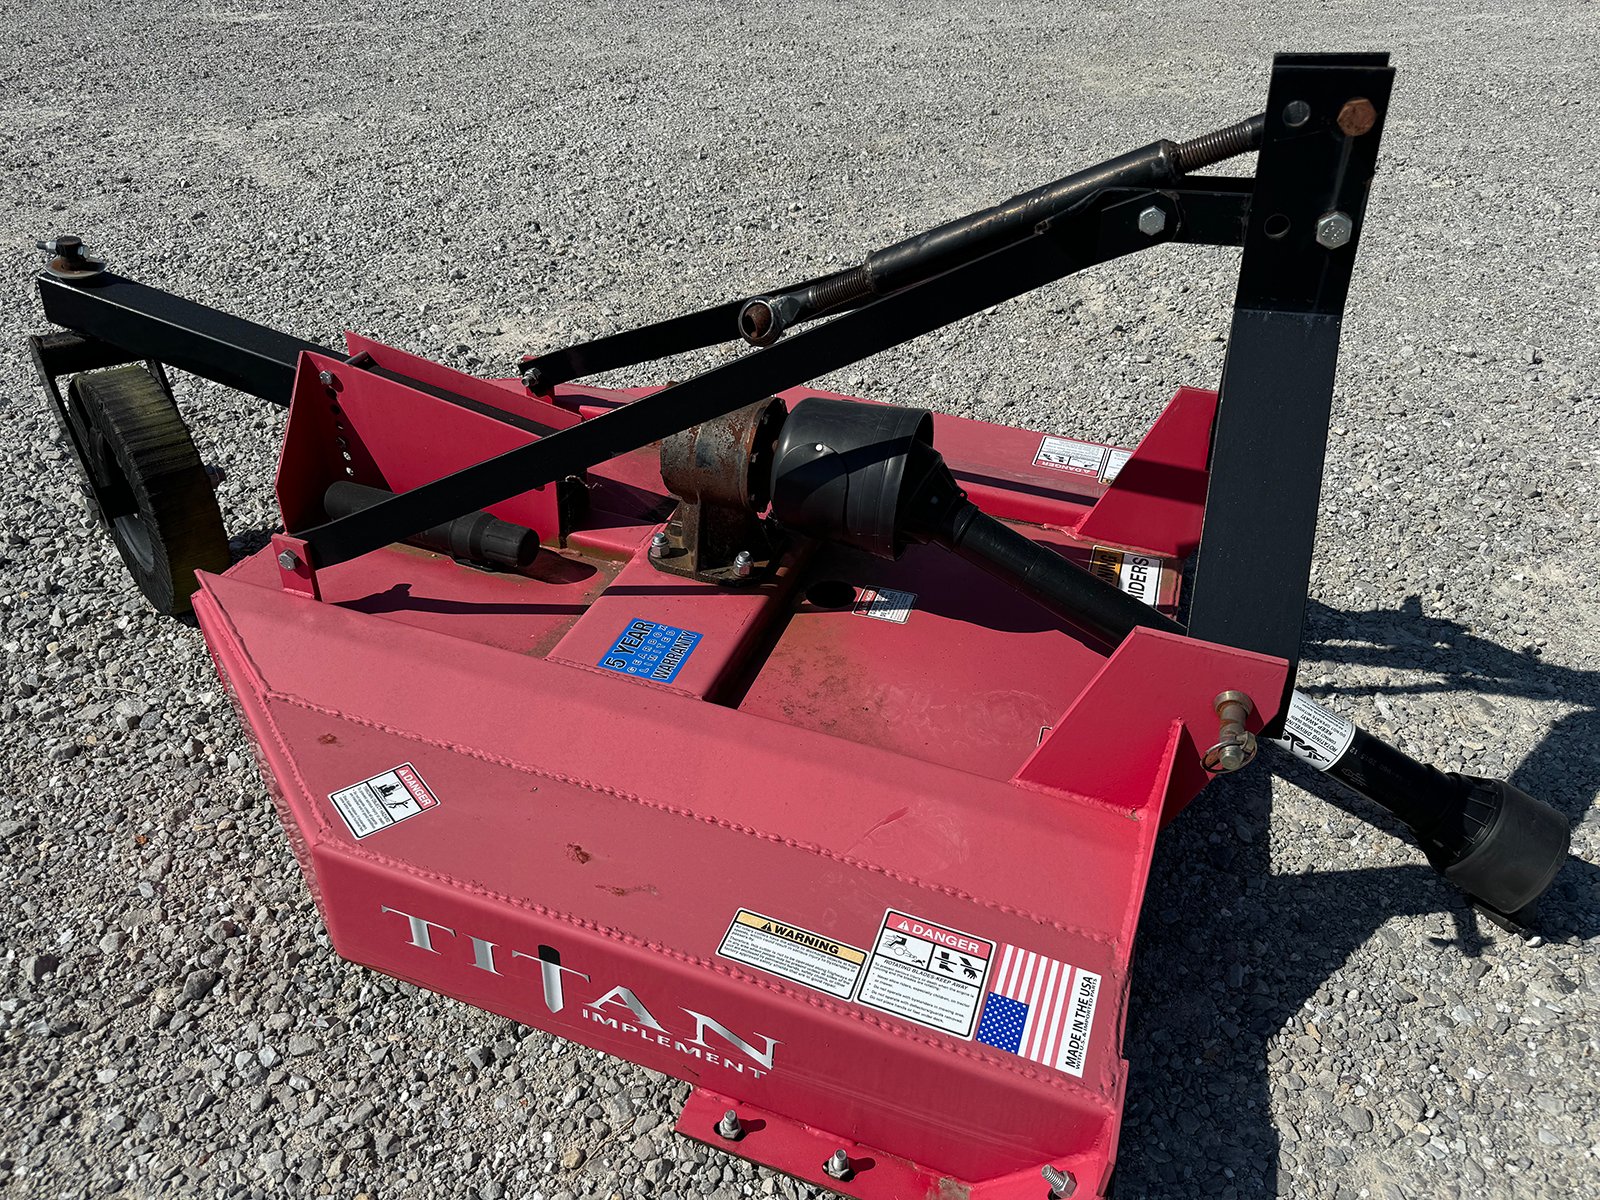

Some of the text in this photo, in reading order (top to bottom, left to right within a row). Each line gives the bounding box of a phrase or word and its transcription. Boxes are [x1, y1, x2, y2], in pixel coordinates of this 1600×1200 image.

[1040, 461, 1081, 472] DANGER
[604, 620, 656, 669] 5 YEAR
[627, 625, 668, 673] GEARBOX
[639, 630, 676, 673] LIMITED
[650, 630, 698, 680] WARRANTY
[1311, 734, 1338, 753] ROTATING
[1317, 724, 1333, 736] KEEP
[402, 773, 433, 806] DANGER
[772, 924, 840, 954] WARNING
[911, 923, 980, 953] DANGER
[381, 905, 786, 1070] TITAN
[583, 1008, 767, 1079] IMPLEMENT
[1065, 976, 1093, 1068] MADE IN THE USA
